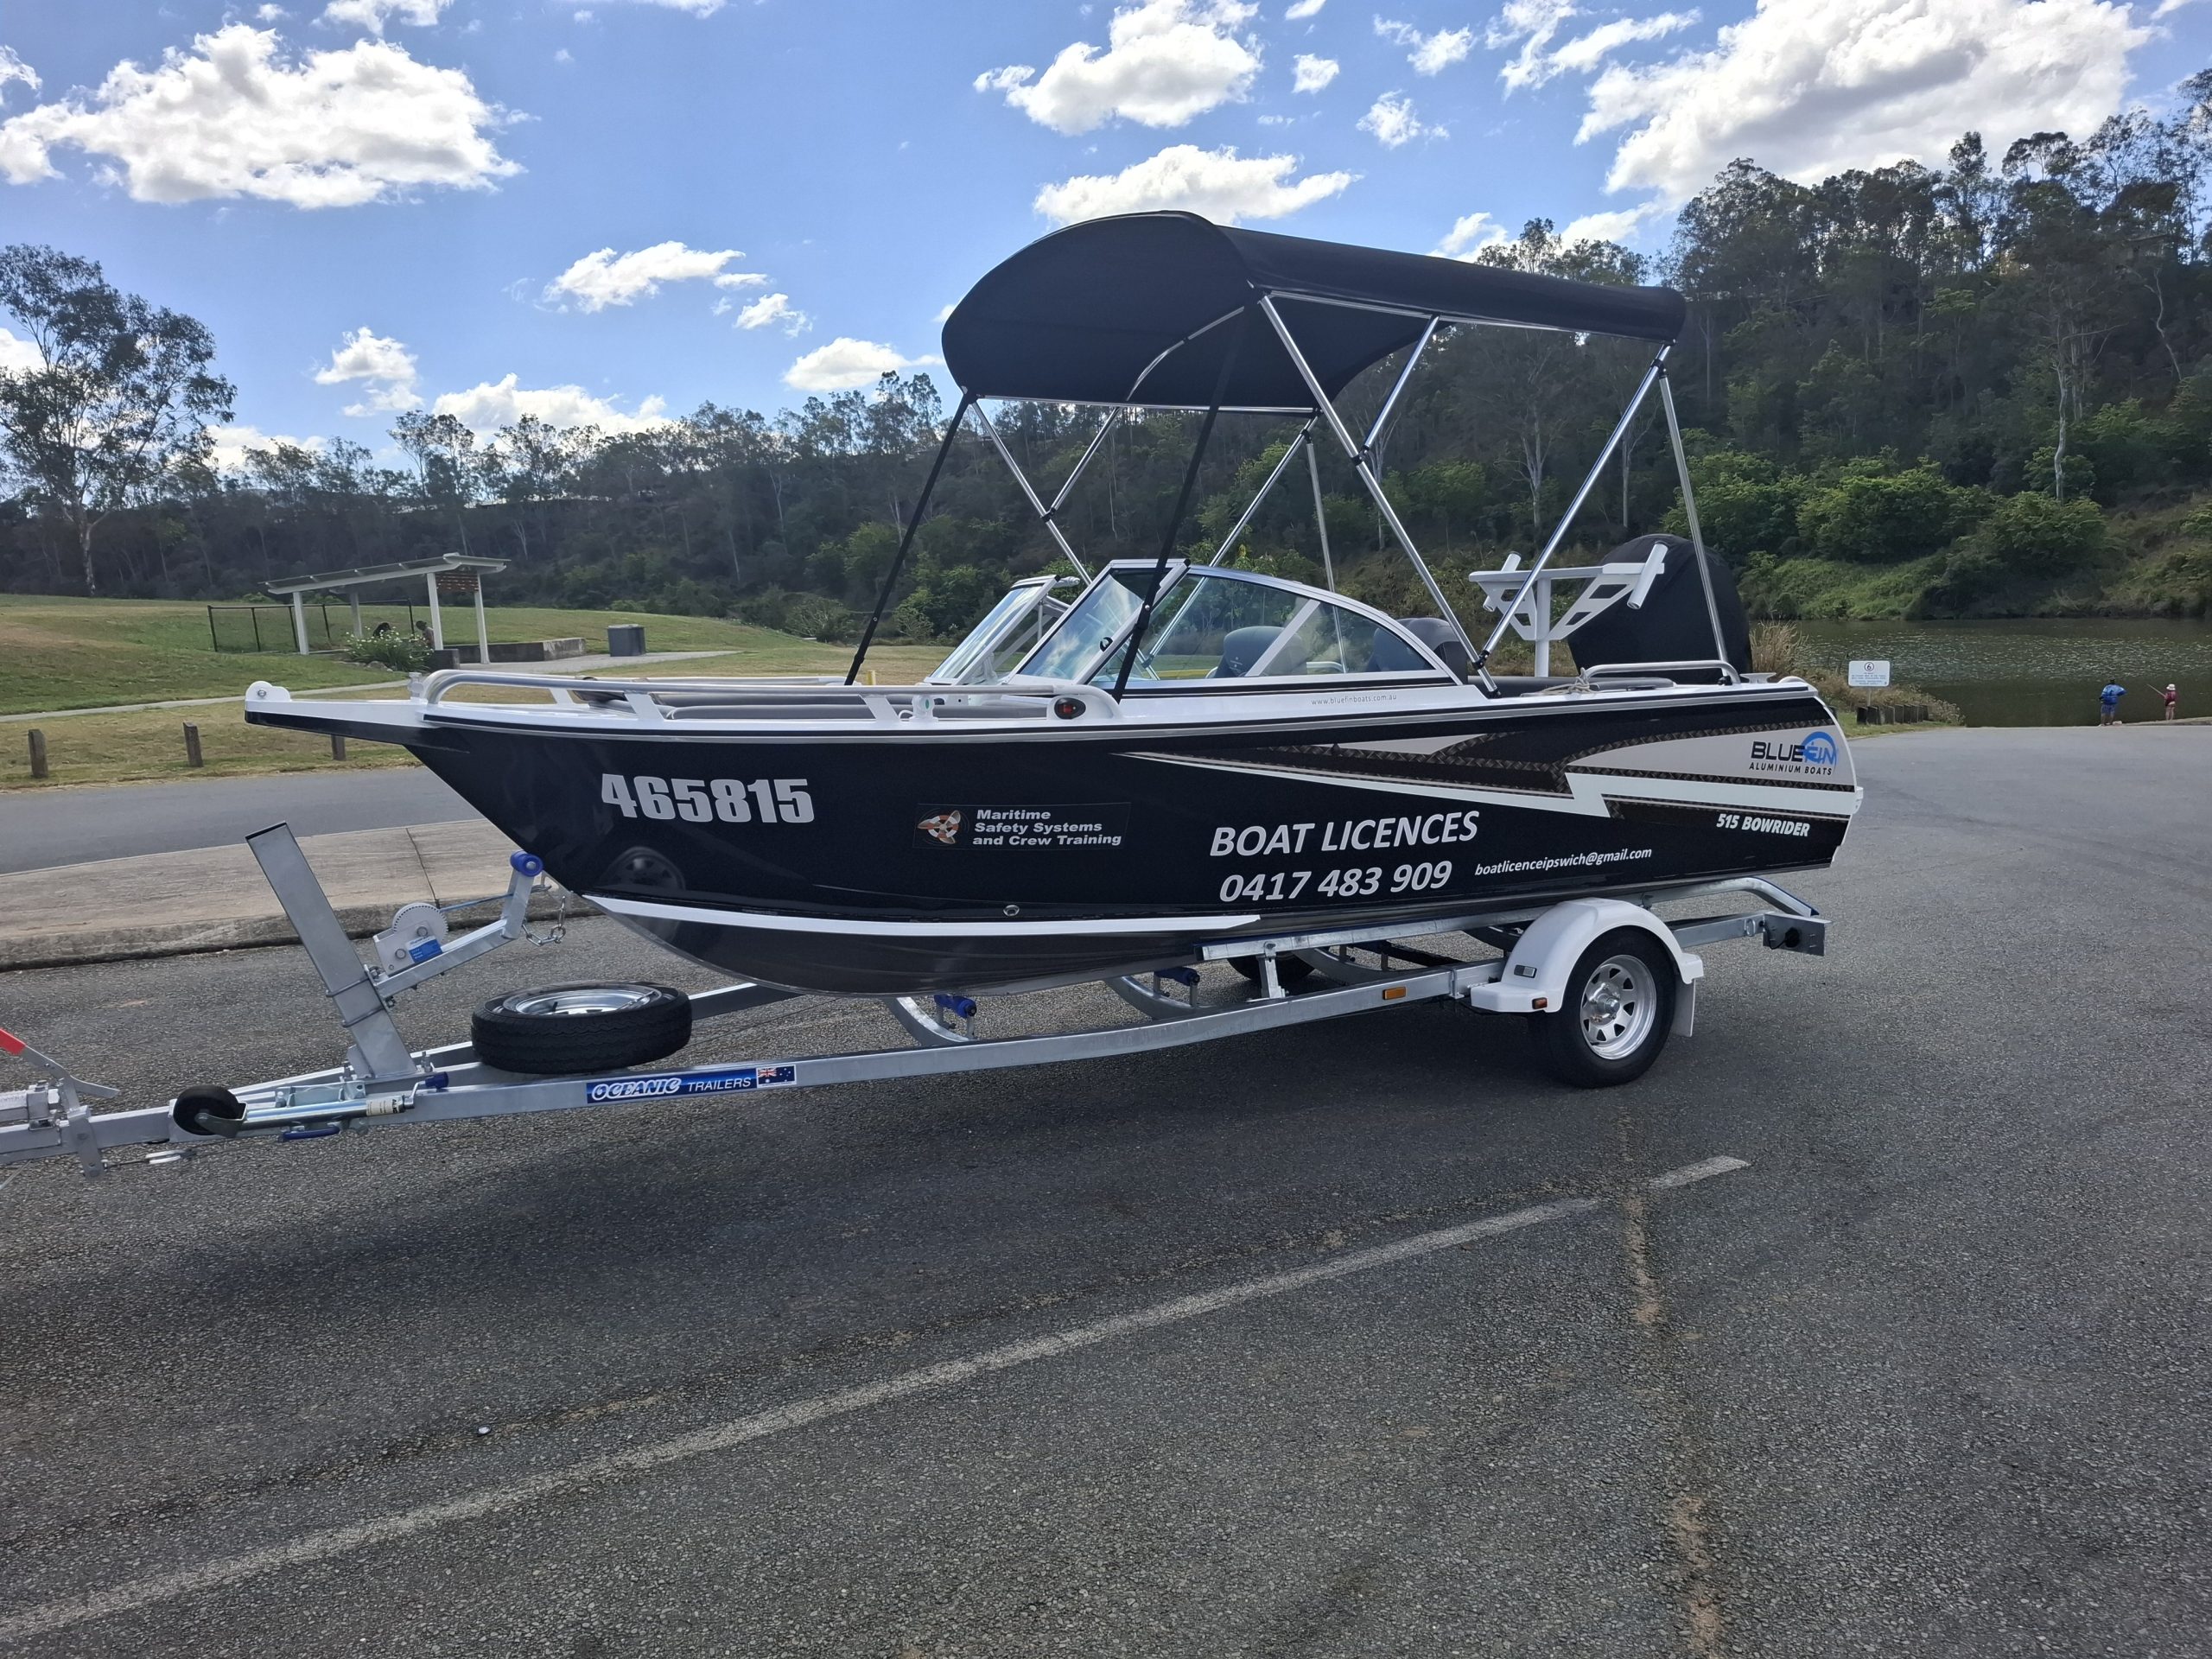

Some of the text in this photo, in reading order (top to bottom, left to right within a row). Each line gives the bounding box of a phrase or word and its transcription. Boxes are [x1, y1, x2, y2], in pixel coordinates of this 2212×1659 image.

[1312, 694, 1397, 705] www.bluefinboats.com.au
[1751, 741, 1834, 765] BLUEFIN
[1749, 762, 1832, 776] ALUMINIUM BOATS
[601, 773, 815, 823] 465815
[976, 810, 1051, 820] Maritime
[1716, 813, 1810, 837] 515 BOWRIDER
[974, 822, 1103, 834] Safety Systems
[1210, 810, 1480, 856] BOAT LICENCES
[972, 835, 1122, 846] and Crew Training
[1474, 849, 1652, 876] boatlicenceipswich@gmail.com
[1219, 861, 1452, 902] 0417 483 909
[591, 1077, 752, 1101] OCEANIC TRAILERS
